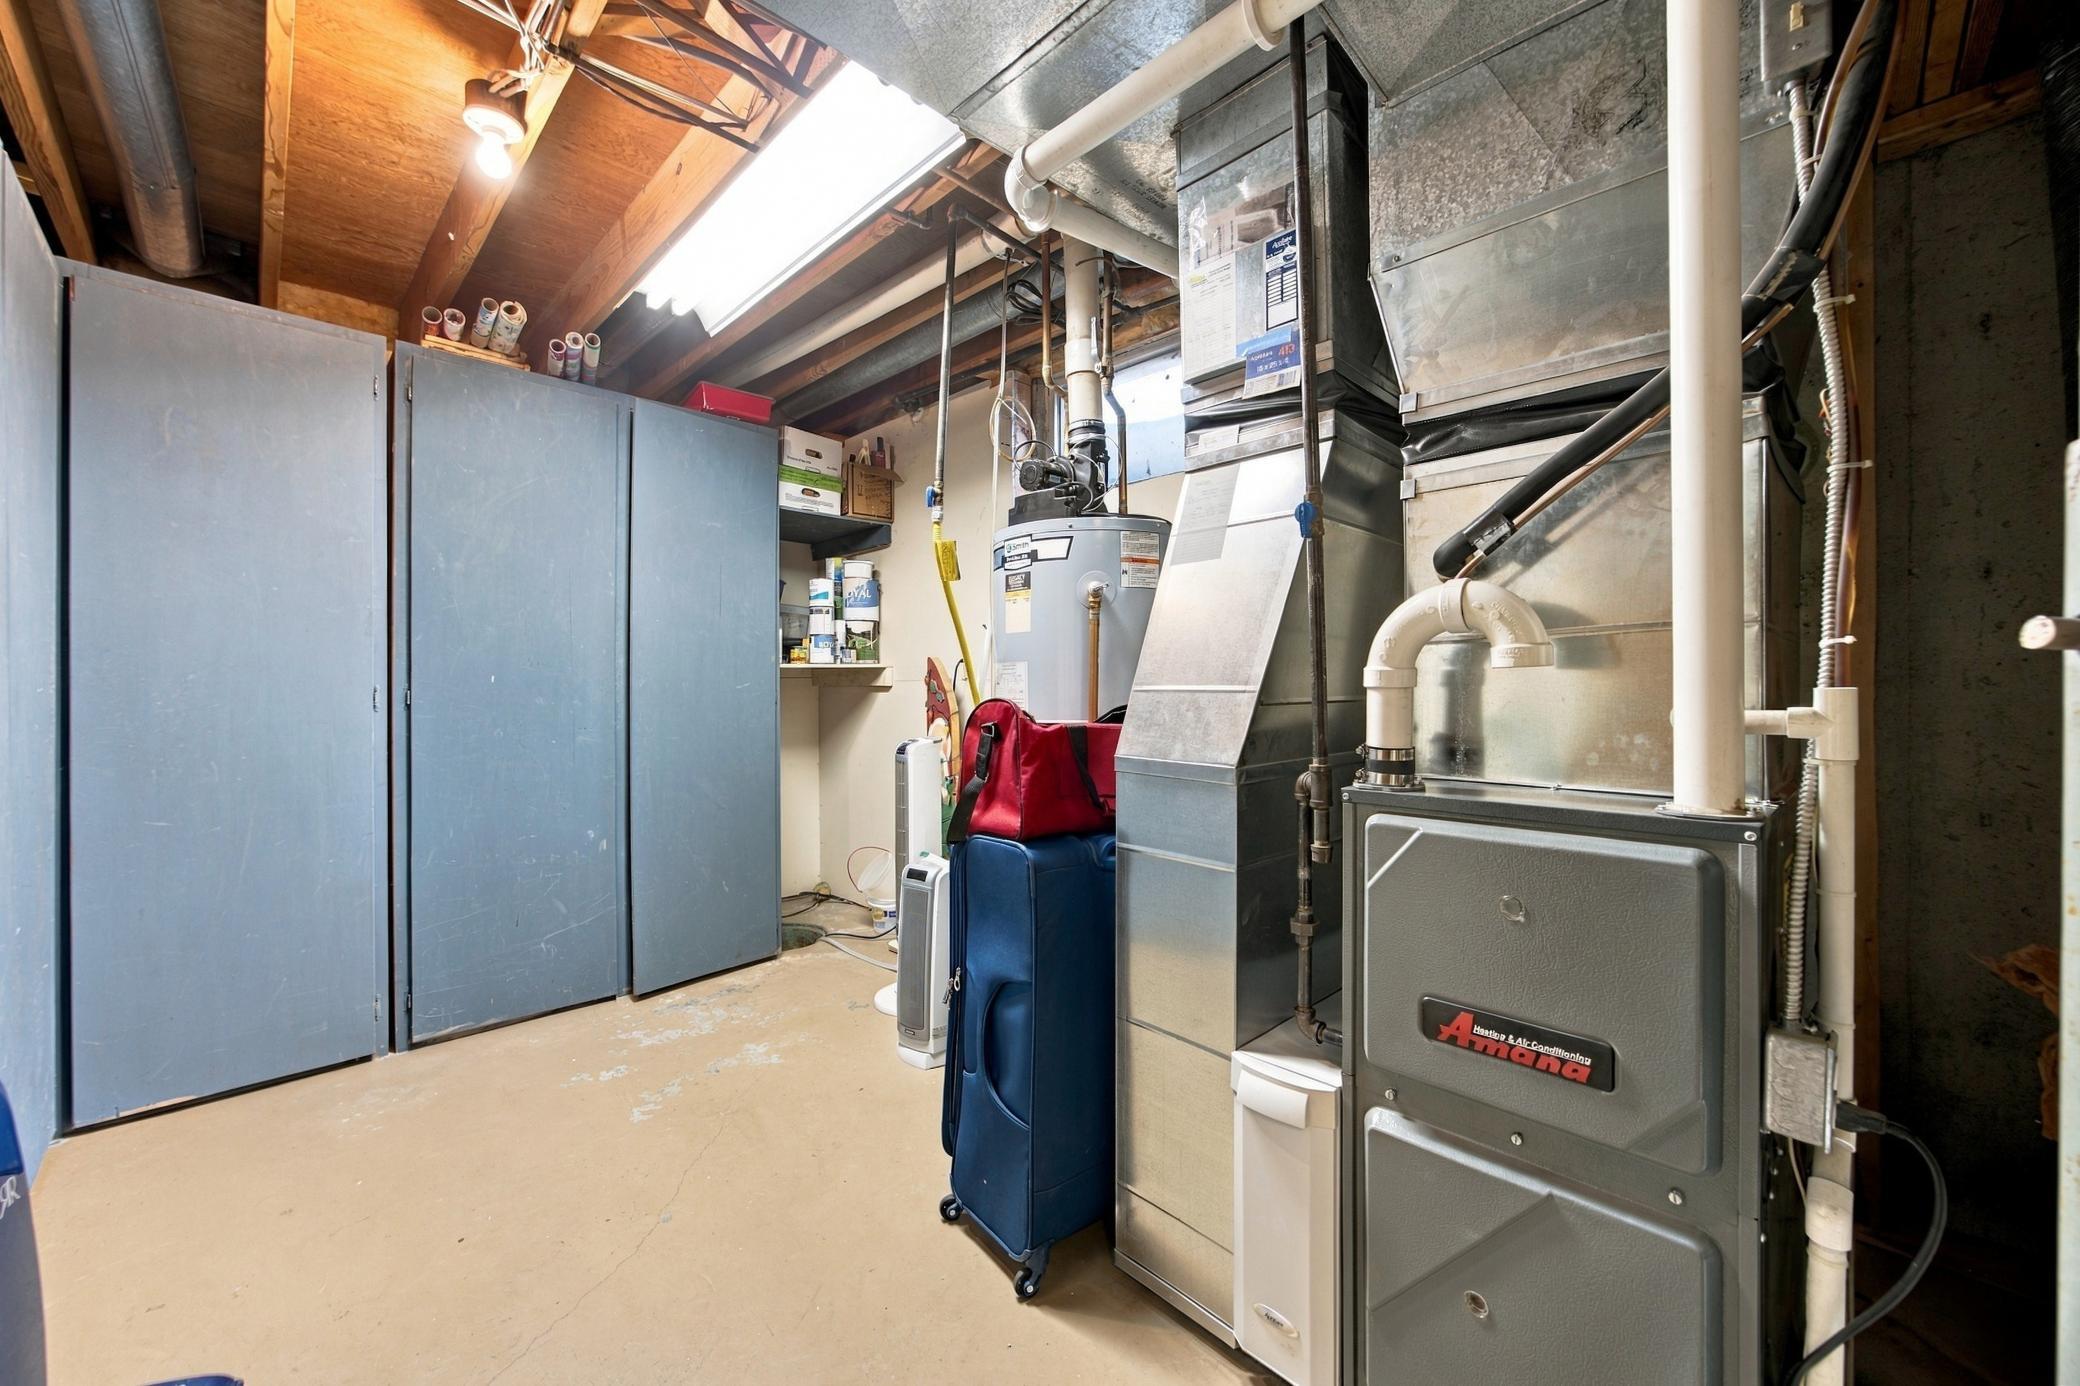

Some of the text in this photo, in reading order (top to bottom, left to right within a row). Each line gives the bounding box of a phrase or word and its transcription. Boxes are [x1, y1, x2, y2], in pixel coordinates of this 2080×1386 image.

[1437, 1011, 1592, 1084] Amana
[1473, 1024, 1592, 1066] Heating & Air Conditioning
